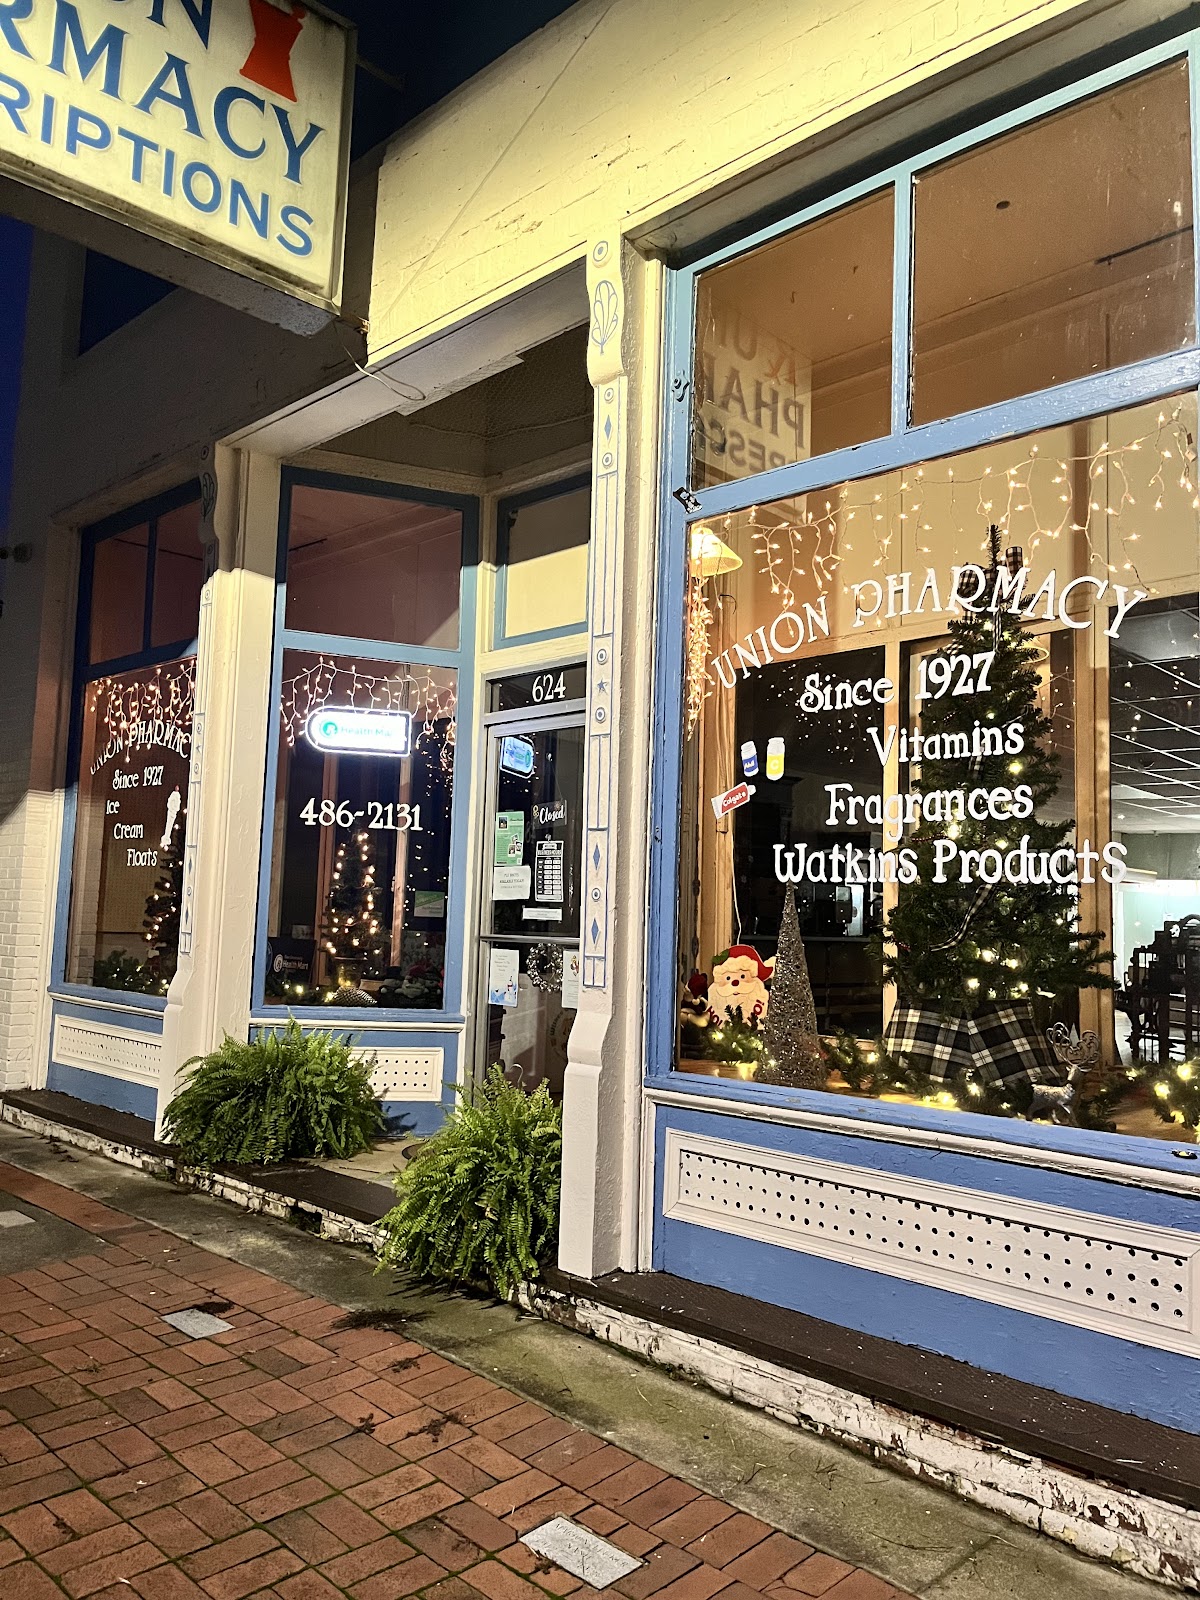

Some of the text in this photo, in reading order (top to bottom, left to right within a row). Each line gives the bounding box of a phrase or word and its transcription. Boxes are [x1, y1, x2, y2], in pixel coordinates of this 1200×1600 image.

[711, 564, 1148, 690] UNION PHARMACY
[532, 672, 566, 702] 624
[800, 651, 997, 713] Since 1927
[129, 719, 191, 762] PHARMAC
[867, 720, 1025, 768] Vitamins
[112, 765, 164, 789] Since 1927
[106, 800, 120, 814] Ice
[300, 797, 423, 831] 486-2131
[540, 805, 564, 824] Closed
[825, 782, 1034, 842] Fragrances
[114, 823, 144, 839] Cream
[126, 848, 158, 866] Floats
[773, 835, 1128, 885] Watkins Products
